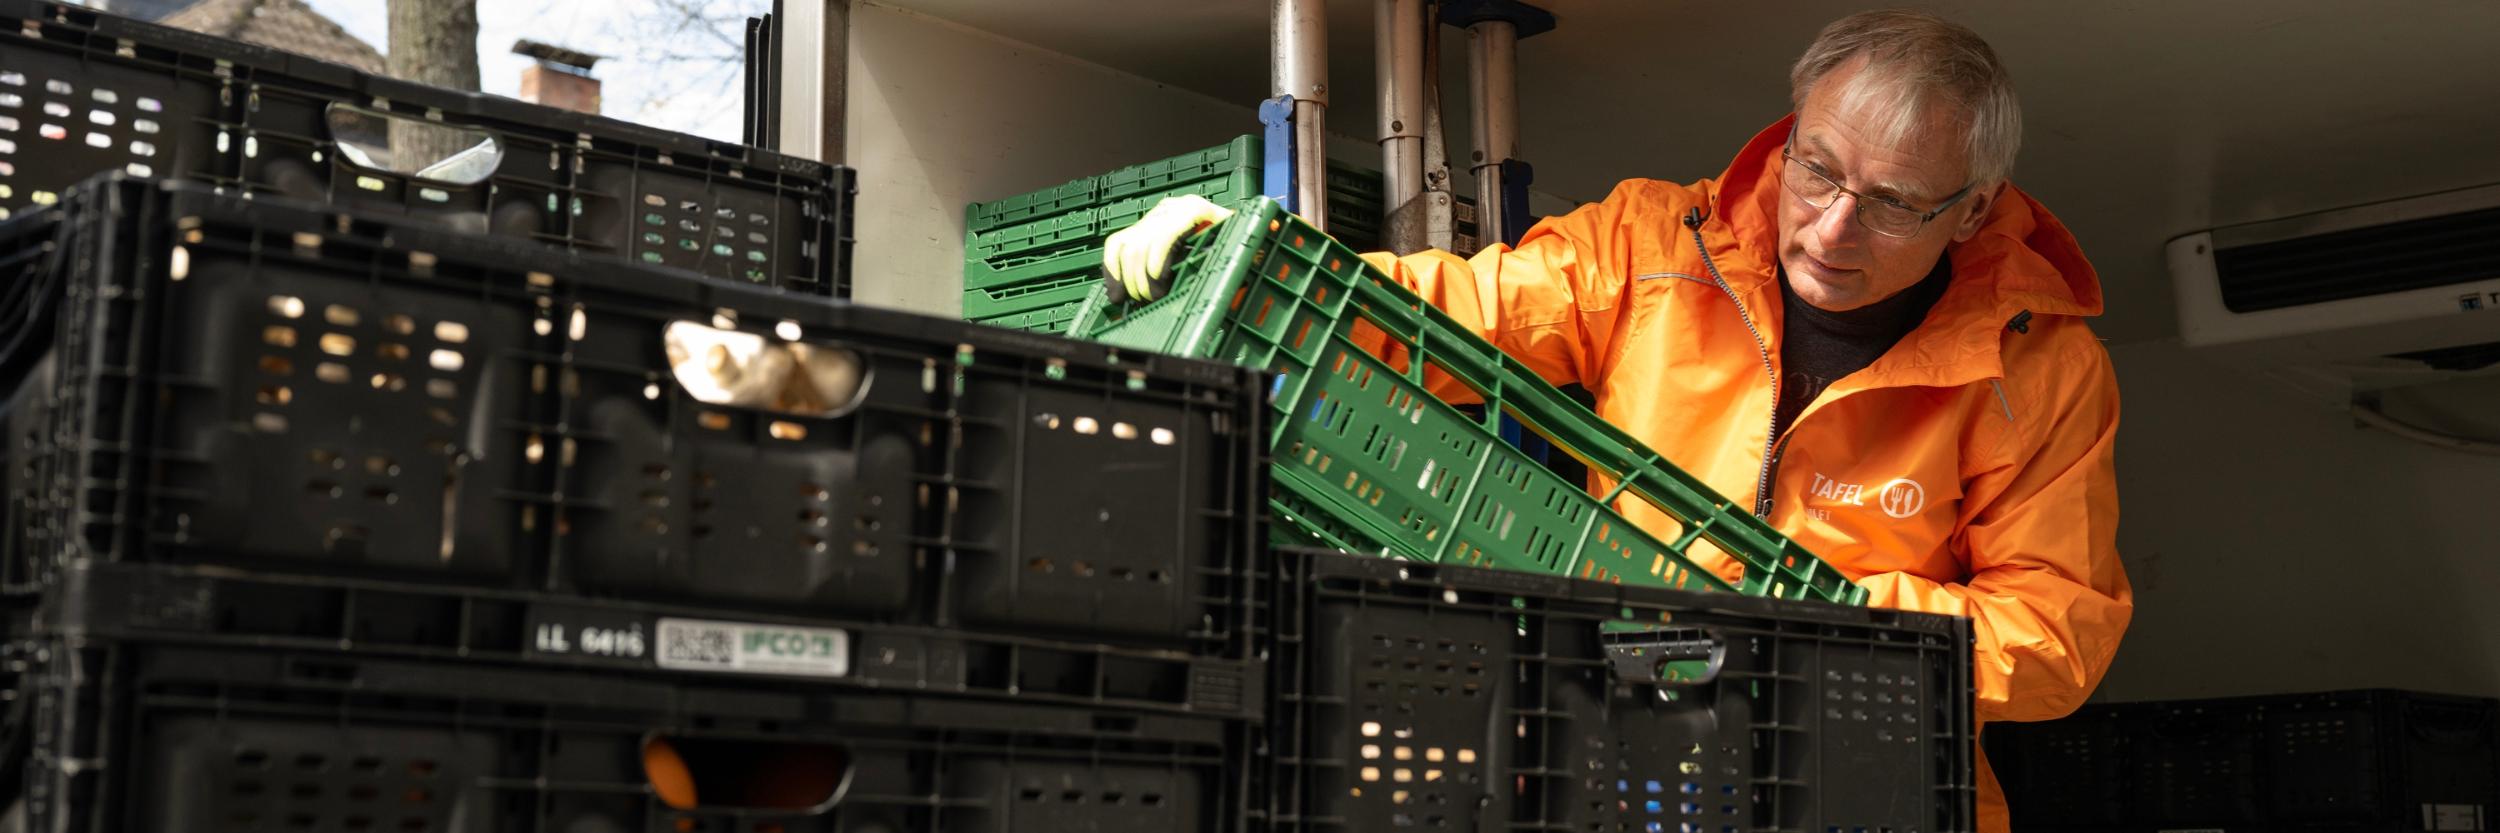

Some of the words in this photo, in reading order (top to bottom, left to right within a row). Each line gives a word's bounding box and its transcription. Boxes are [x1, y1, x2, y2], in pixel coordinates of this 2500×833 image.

[1810, 472, 1865, 506] TAFEL
[536, 623, 571, 653] LL
[742, 631, 807, 656] IFCO
